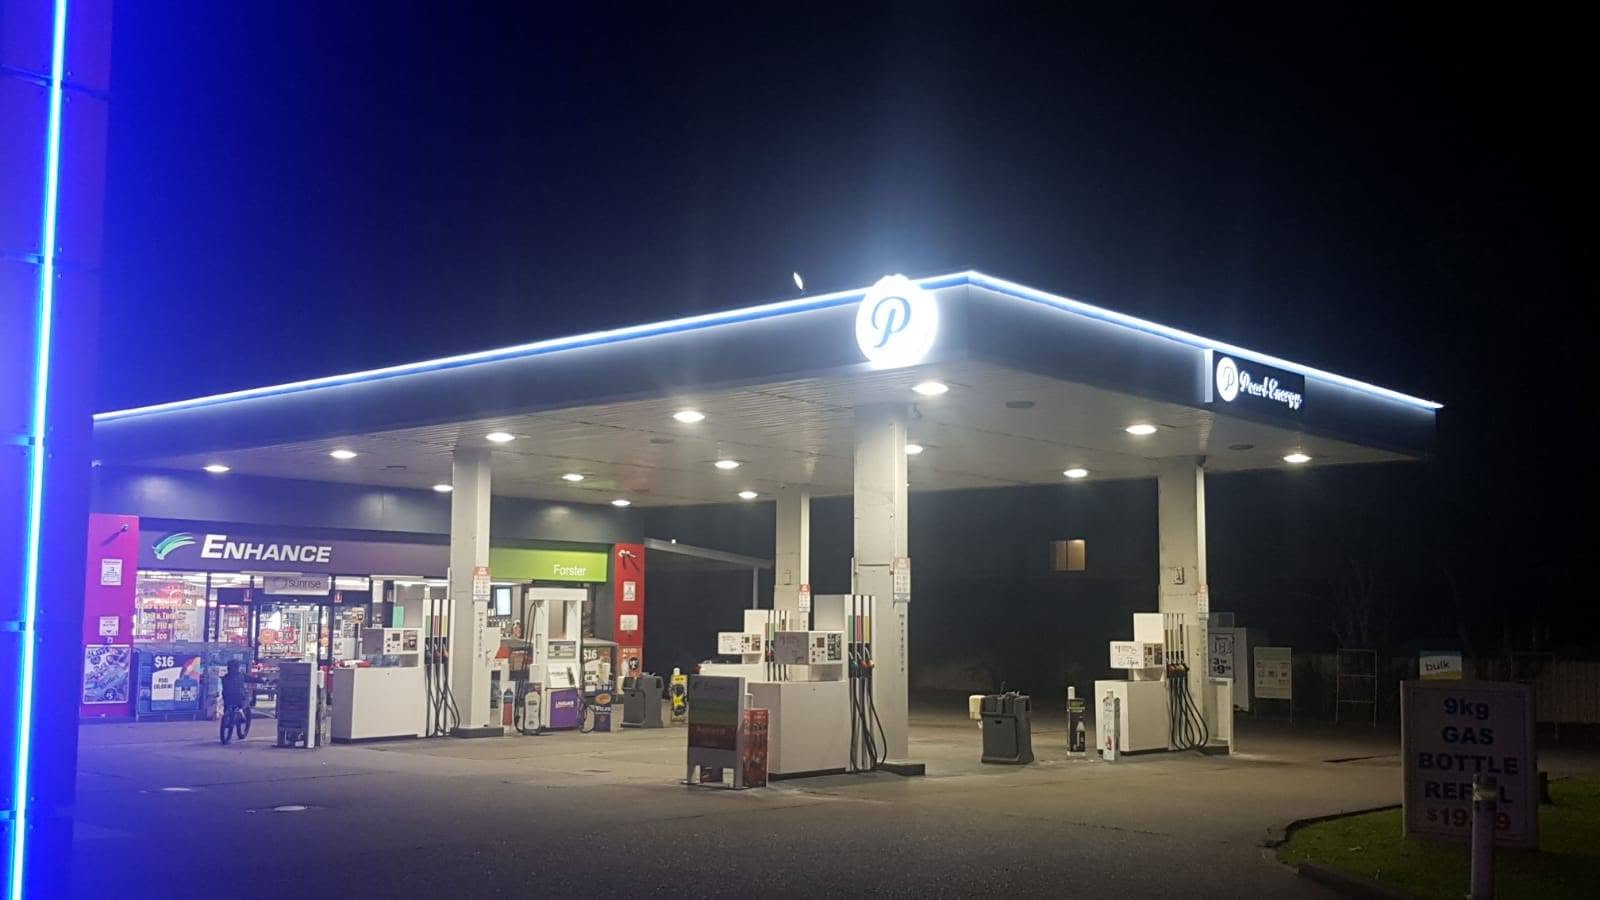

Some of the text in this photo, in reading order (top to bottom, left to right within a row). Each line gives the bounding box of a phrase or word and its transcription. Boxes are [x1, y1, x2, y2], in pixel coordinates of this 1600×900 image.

[871, 296, 911, 348] P
[1239, 370, 1303, 410] Pearl Energy
[201, 534, 332, 562] ENHANCE
[552, 564, 587, 576] Forster
[289, 579, 321, 589] sunrise
[154, 656, 174, 668] $16
[1425, 662, 1449, 671] bulk
[1443, 698, 1489, 720] 9kg
[1441, 726, 1494, 745] GAS
[1418, 752, 1519, 775] BOTTLE
[1424, 782, 1513, 803] REFL
[1426, 807, 1511, 830] $19.9
